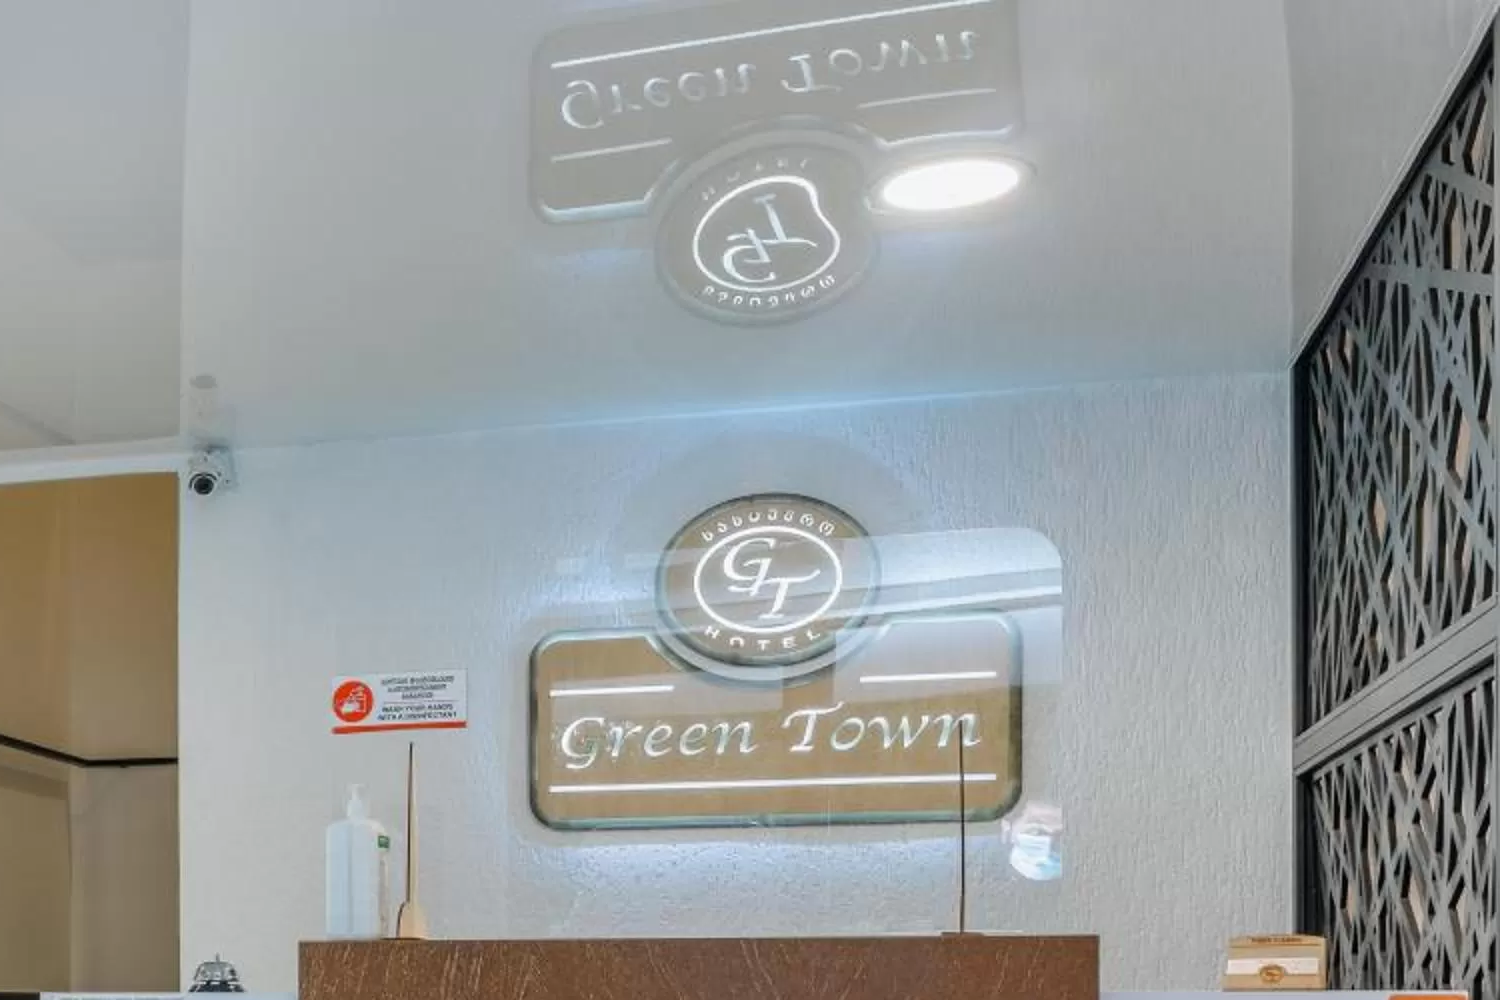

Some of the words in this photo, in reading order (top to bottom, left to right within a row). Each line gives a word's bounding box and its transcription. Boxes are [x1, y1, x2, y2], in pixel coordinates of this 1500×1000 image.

[703, 625, 821, 651] HOTEL
[561, 717, 758, 769] Green
[780, 702, 981, 753] Town
